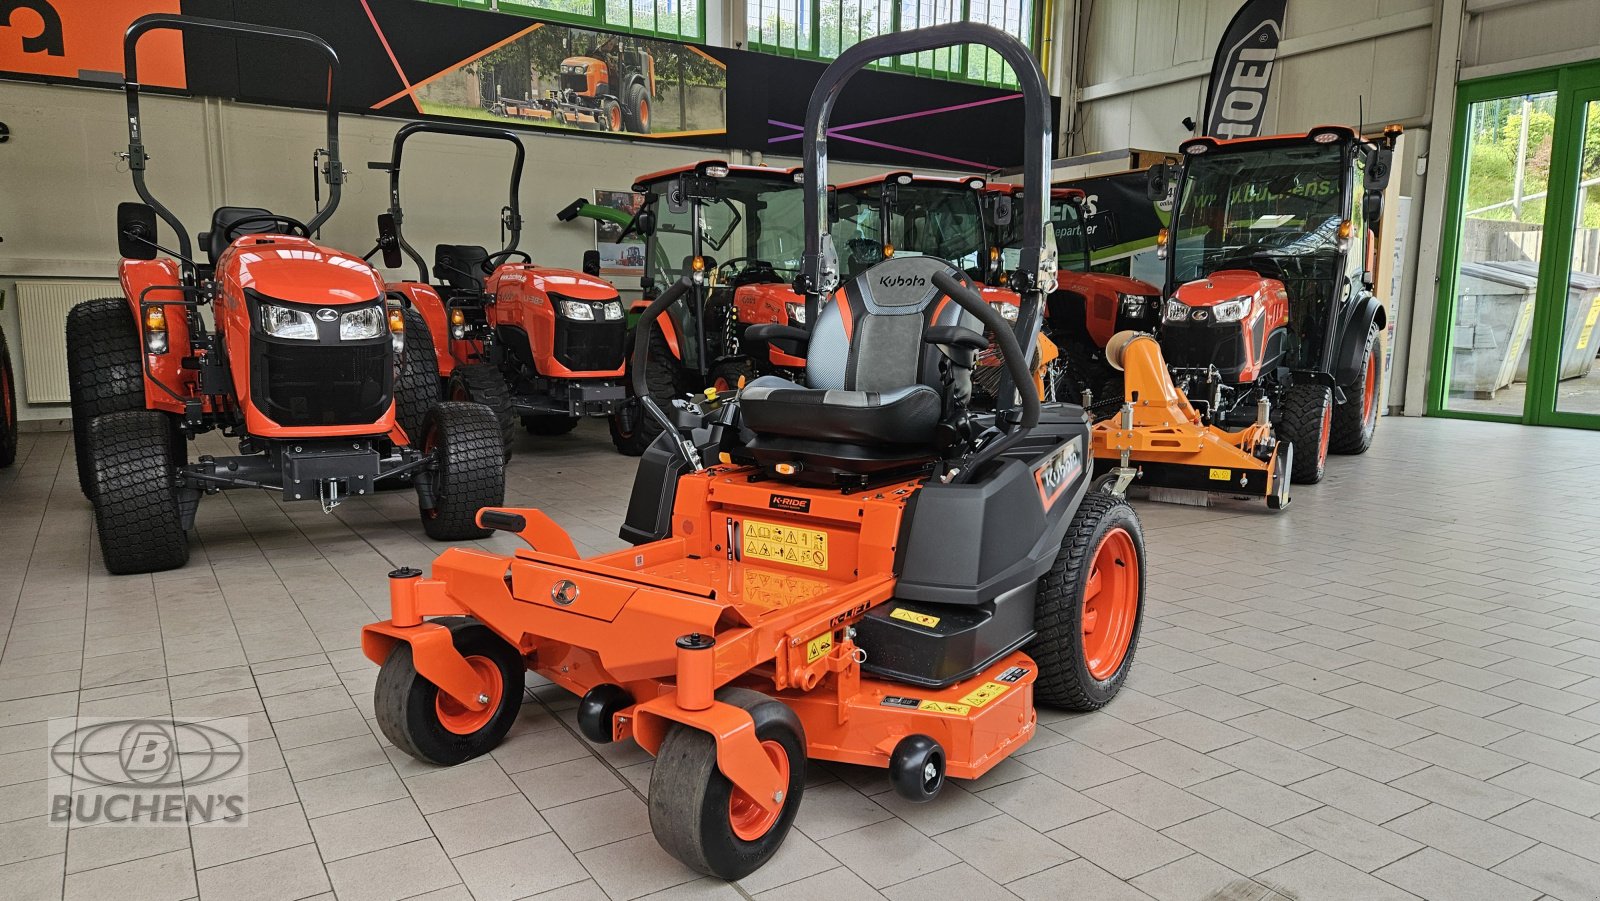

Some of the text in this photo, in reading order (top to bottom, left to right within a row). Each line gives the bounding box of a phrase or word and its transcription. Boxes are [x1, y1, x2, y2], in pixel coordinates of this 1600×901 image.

[880, 275, 926, 287] Kubota
[1045, 452, 1078, 488] Kubota
[773, 497, 807, 508] K-RIDE
